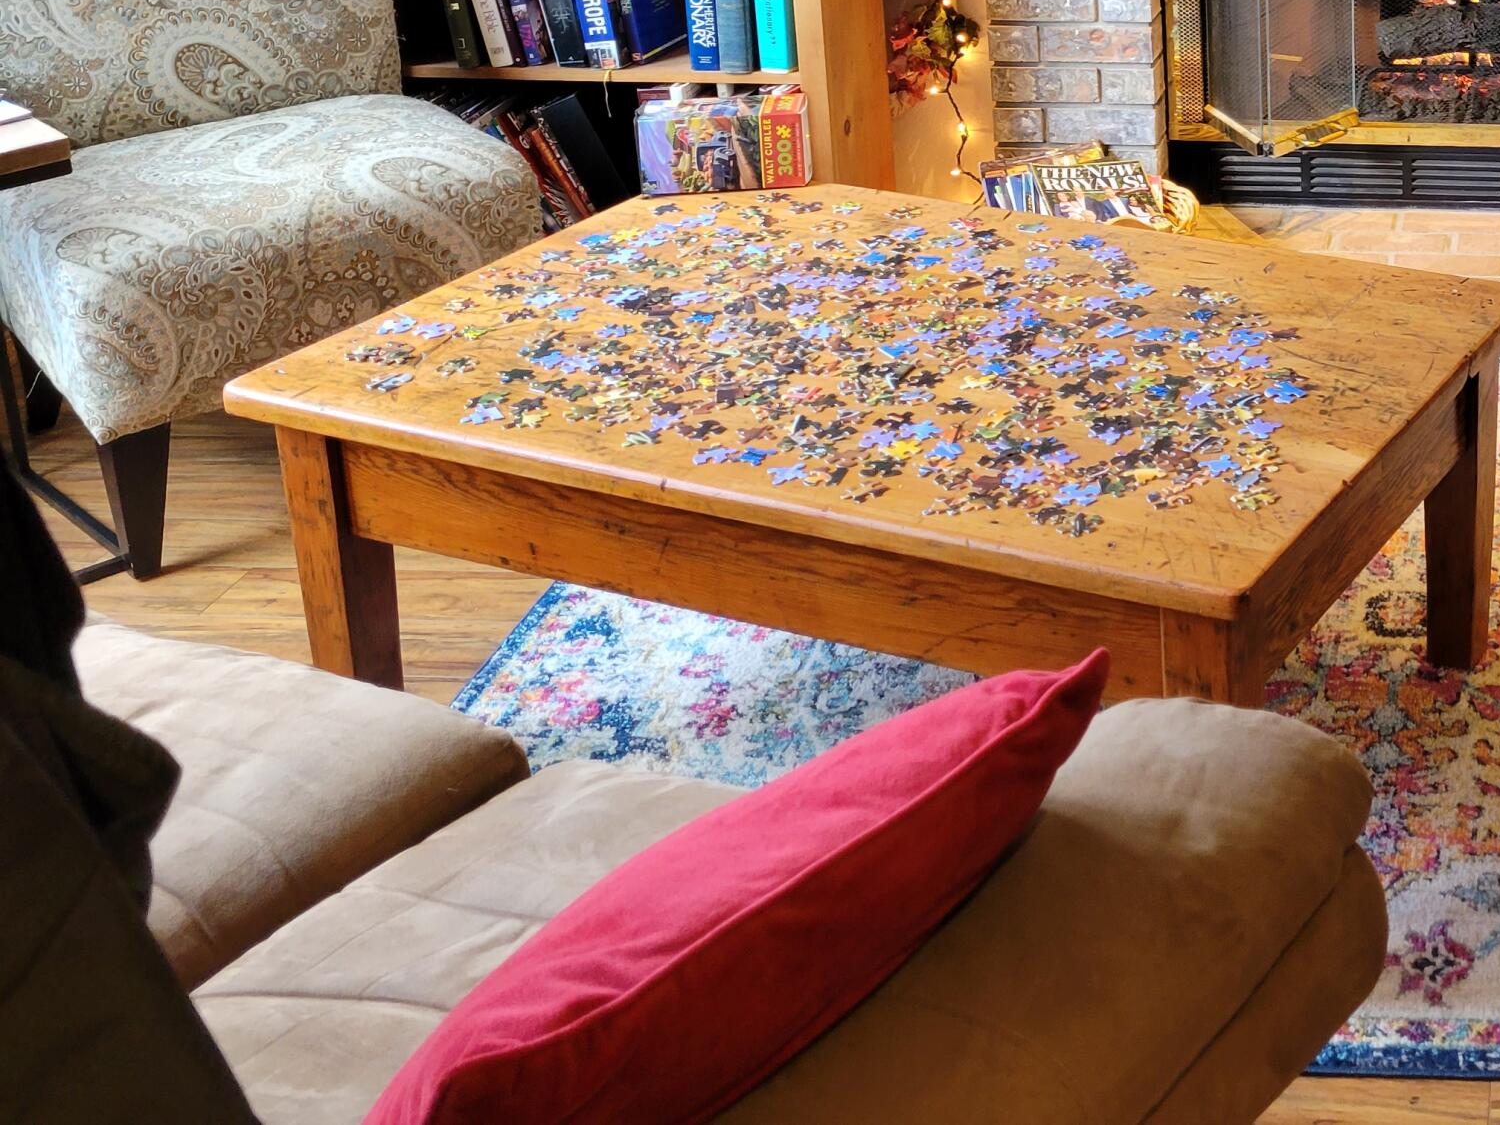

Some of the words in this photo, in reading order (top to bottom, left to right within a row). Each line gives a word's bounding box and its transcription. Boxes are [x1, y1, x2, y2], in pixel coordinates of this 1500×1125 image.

[481, 9, 499, 35] Bible
[703, 4, 716, 48] HERITAGE
[519, 23, 534, 48] 1776
[763, 117, 773, 156] CURLEE
[776, 138, 792, 176] 300
[766, 158, 774, 184] WALT
[1037, 166, 1084, 179] THE
[1084, 162, 1138, 179] NEW
[1042, 174, 1147, 192] ROYALS!
